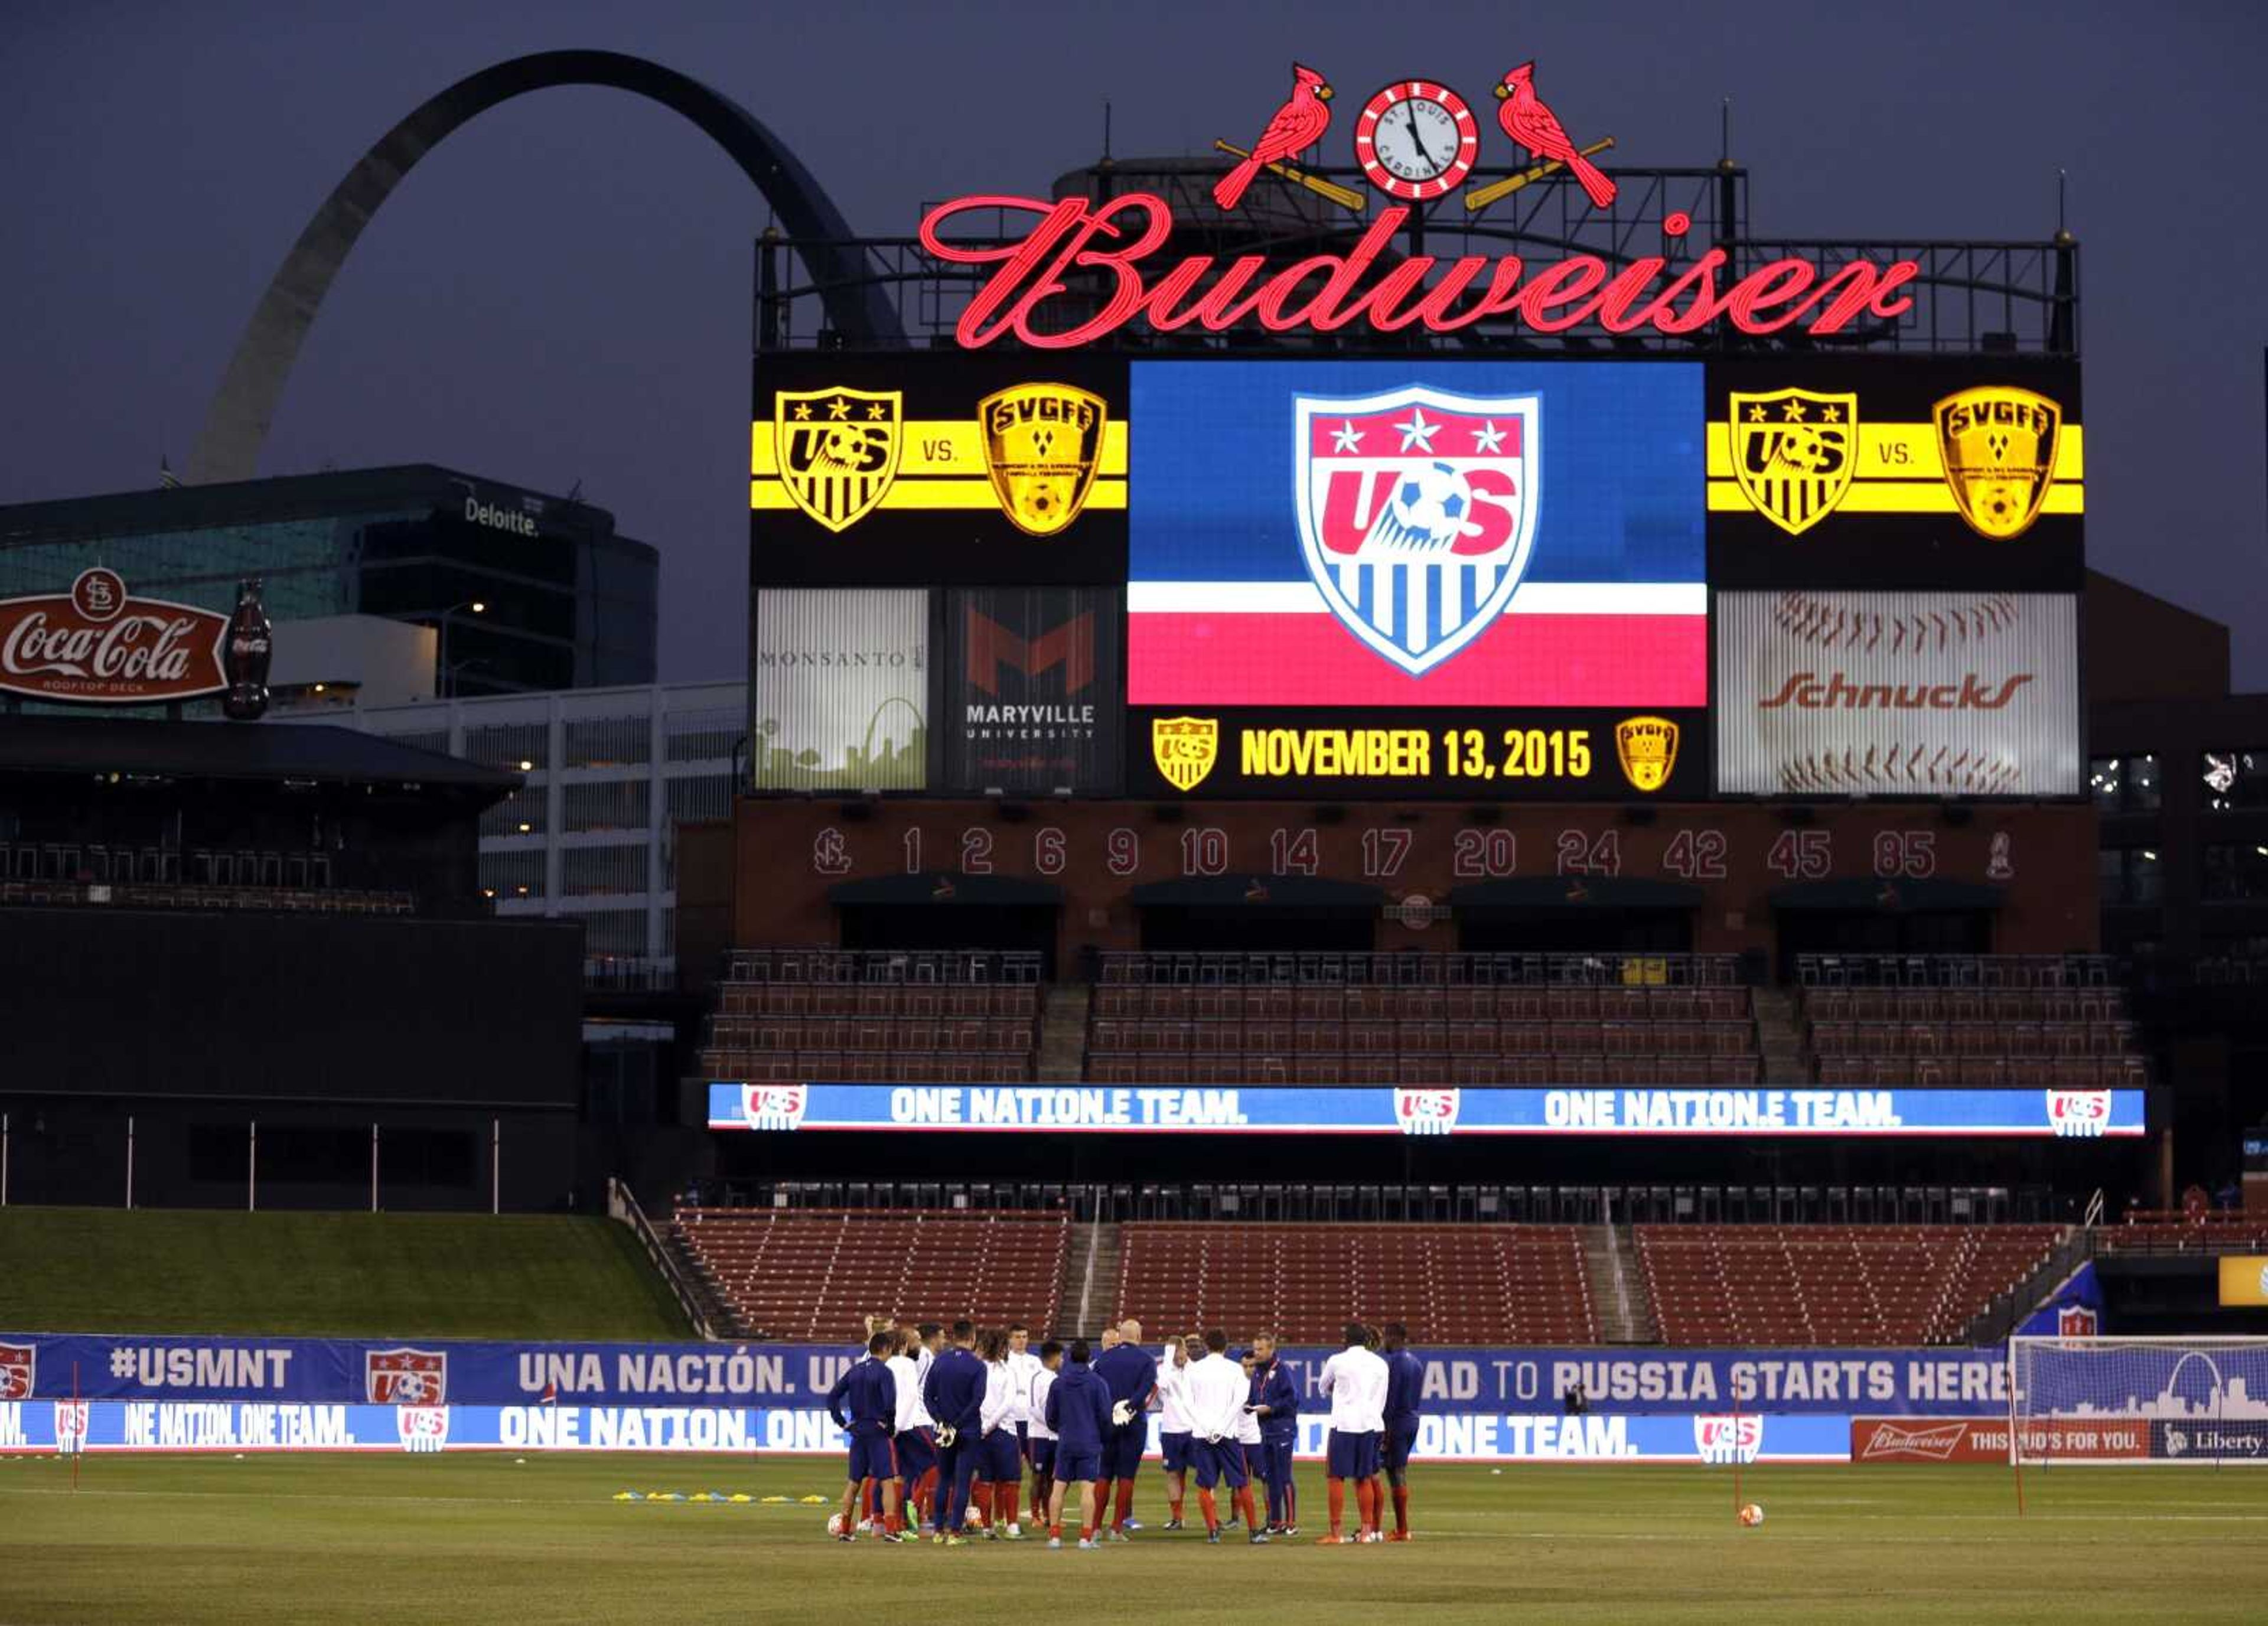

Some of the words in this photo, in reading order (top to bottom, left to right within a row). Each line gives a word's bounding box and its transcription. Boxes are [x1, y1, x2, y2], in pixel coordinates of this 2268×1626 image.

[919, 193, 1918, 350] Budweiser
[995, 396, 1091, 432] SVGFF
[1951, 401, 2048, 435] SVGFF
[923, 440, 958, 462] VS.
[1879, 442, 1914, 465] VS.
[465, 497, 539, 538] Deloitte.
[1321, 468, 1517, 556] US
[2, 611, 198, 680] Coca-Cola
[759, 650, 905, 668] MONSANTO
[1758, 672, 2038, 710] Schnucks
[966, 705, 1094, 724] MARYVILLE
[966, 729, 1094, 739] UNIVERSITY
[1241, 729, 1430, 776] NOVEMBER
[1443, 729, 1494, 780] 13,
[1503, 729, 1591, 776] 2015
[905, 827, 921, 874] 1
[962, 828, 993, 874] 2
[1035, 828, 1067, 874] 6
[1107, 828, 1139, 874] 9
[1181, 828, 1228, 875] 10
[1270, 828, 1318, 875] 14
[1361, 828, 1412, 875] 17
[1454, 829, 1517, 876] 20
[1557, 829, 1620, 876] 24
[1663, 829, 1728, 877] 42
[1768, 829, 1832, 877] 45
[1873, 829, 1936, 878] 85
[891, 1087, 962, 1122] ONE
[1136, 1089, 1248, 1124] TEAM.
[1544, 1090, 1616, 1126] ONE
[1791, 1091, 1902, 1126] TEAM.
[110, 1347, 292, 1387] #USMNT
[519, 1353, 605, 1393] UNA
[618, 1345, 796, 1394] NACIÓN.
[1421, 1360, 1478, 1399] AD
[1492, 1360, 1538, 1399] TO
[1553, 1361, 1718, 1400] RUSSIA
[1730, 1361, 1894, 1400] STARTS
[125, 1402, 155, 1445] NE
[159, 1403, 236, 1445] NATION.
[240, 1405, 276, 1445] ONE
[279, 1405, 354, 1445] TEAM.
[500, 1406, 579, 1446] ONE
[591, 1407, 757, 1448] NATION.
[1416, 1415, 1498, 1455] ONE
[1507, 1415, 1638, 1455] TEAM.
[1873, 1431, 1957, 1449] Budweiser
[1971, 1432, 2008, 1451] THIS
[2067, 1432, 2098, 1451] FOR
[2103, 1432, 2141, 1451] YOU.
[2196, 1431, 2264, 1455] Liberty
